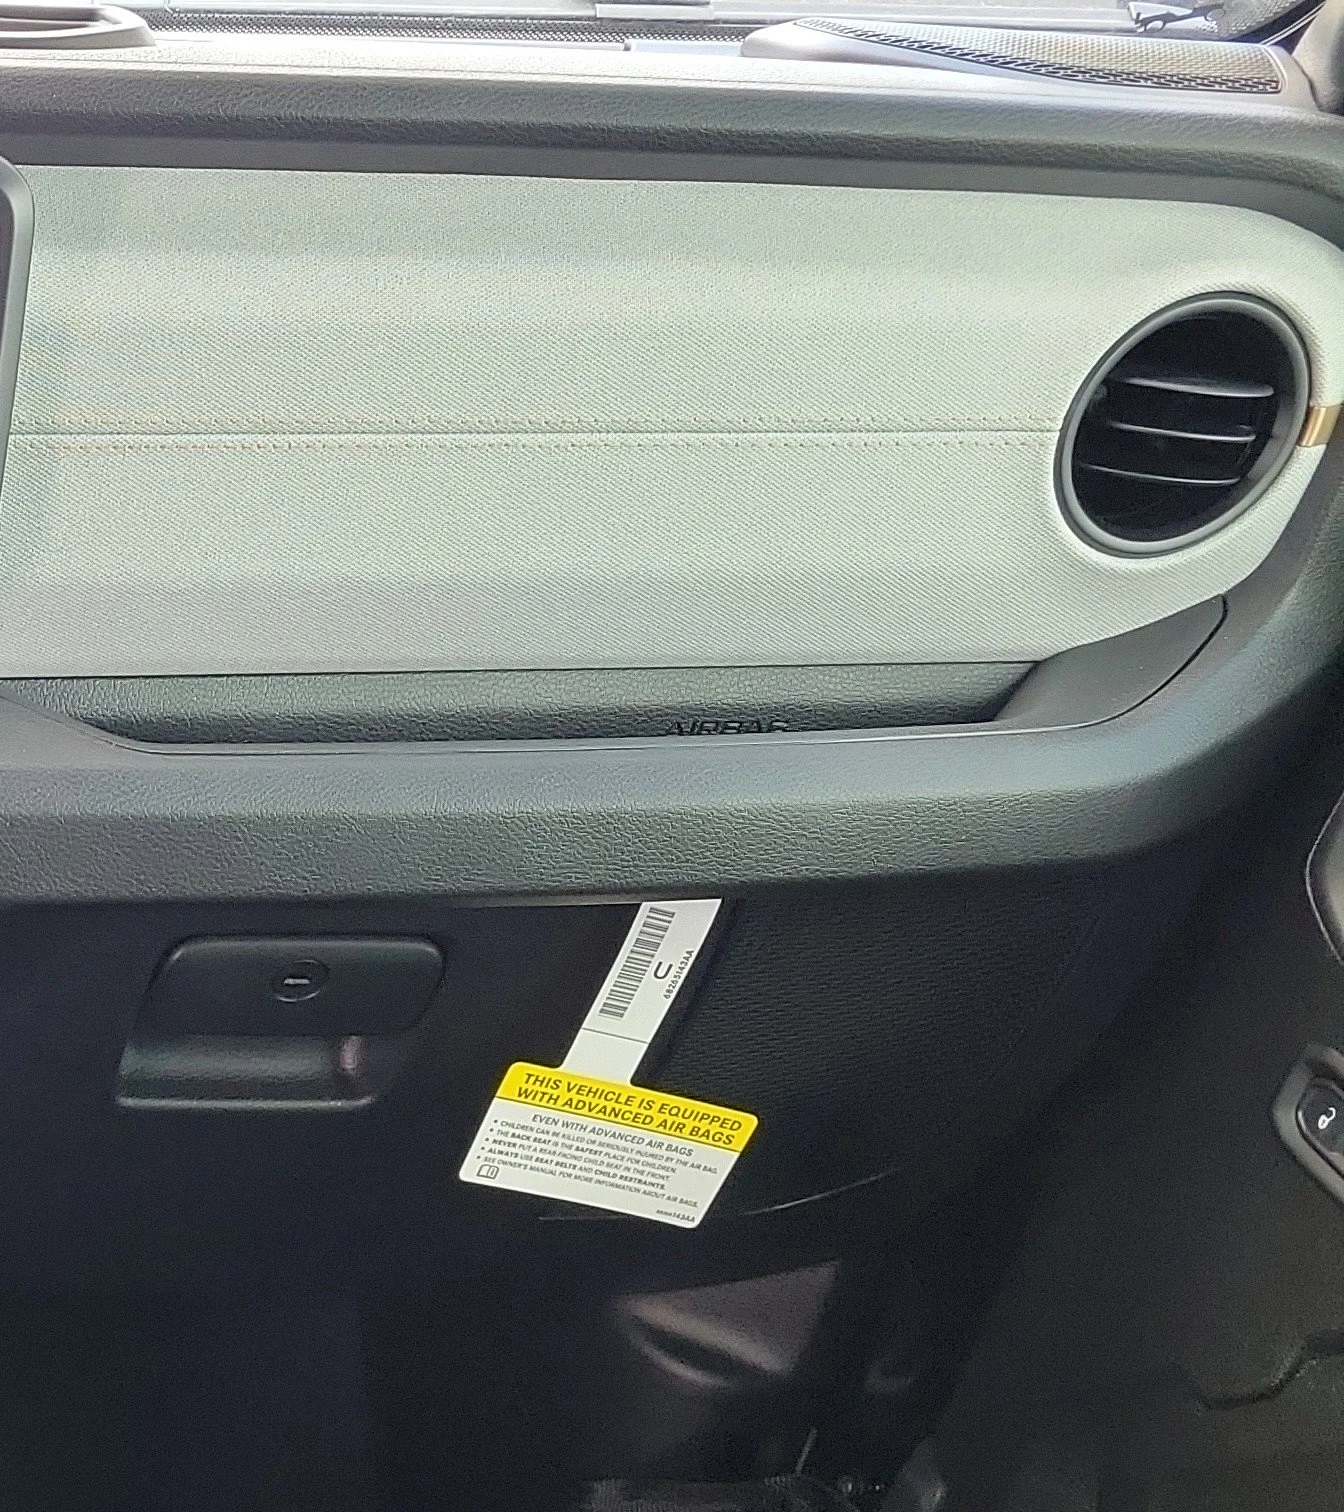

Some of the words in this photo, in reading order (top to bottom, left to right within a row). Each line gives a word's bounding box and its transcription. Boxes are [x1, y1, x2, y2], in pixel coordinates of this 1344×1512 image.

[516, 1086, 561, 1106] WITH
[562, 1098, 655, 1126] ADVANCED
[656, 1118, 687, 1134] AIR
[688, 1126, 736, 1146] BAGS
[524, 1072, 563, 1090] THIS
[566, 1081, 637, 1107] VEHICLE
[637, 1098, 656, 1112] IS
[657, 1102, 743, 1132] EQUIPPED
[532, 1114, 560, 1127] EVEN
[562, 1119, 589, 1133] WITH
[588, 1126, 646, 1146] ADVANCED
[646, 1139, 665, 1151] AIR
[665, 1143, 694, 1157] BAGS
